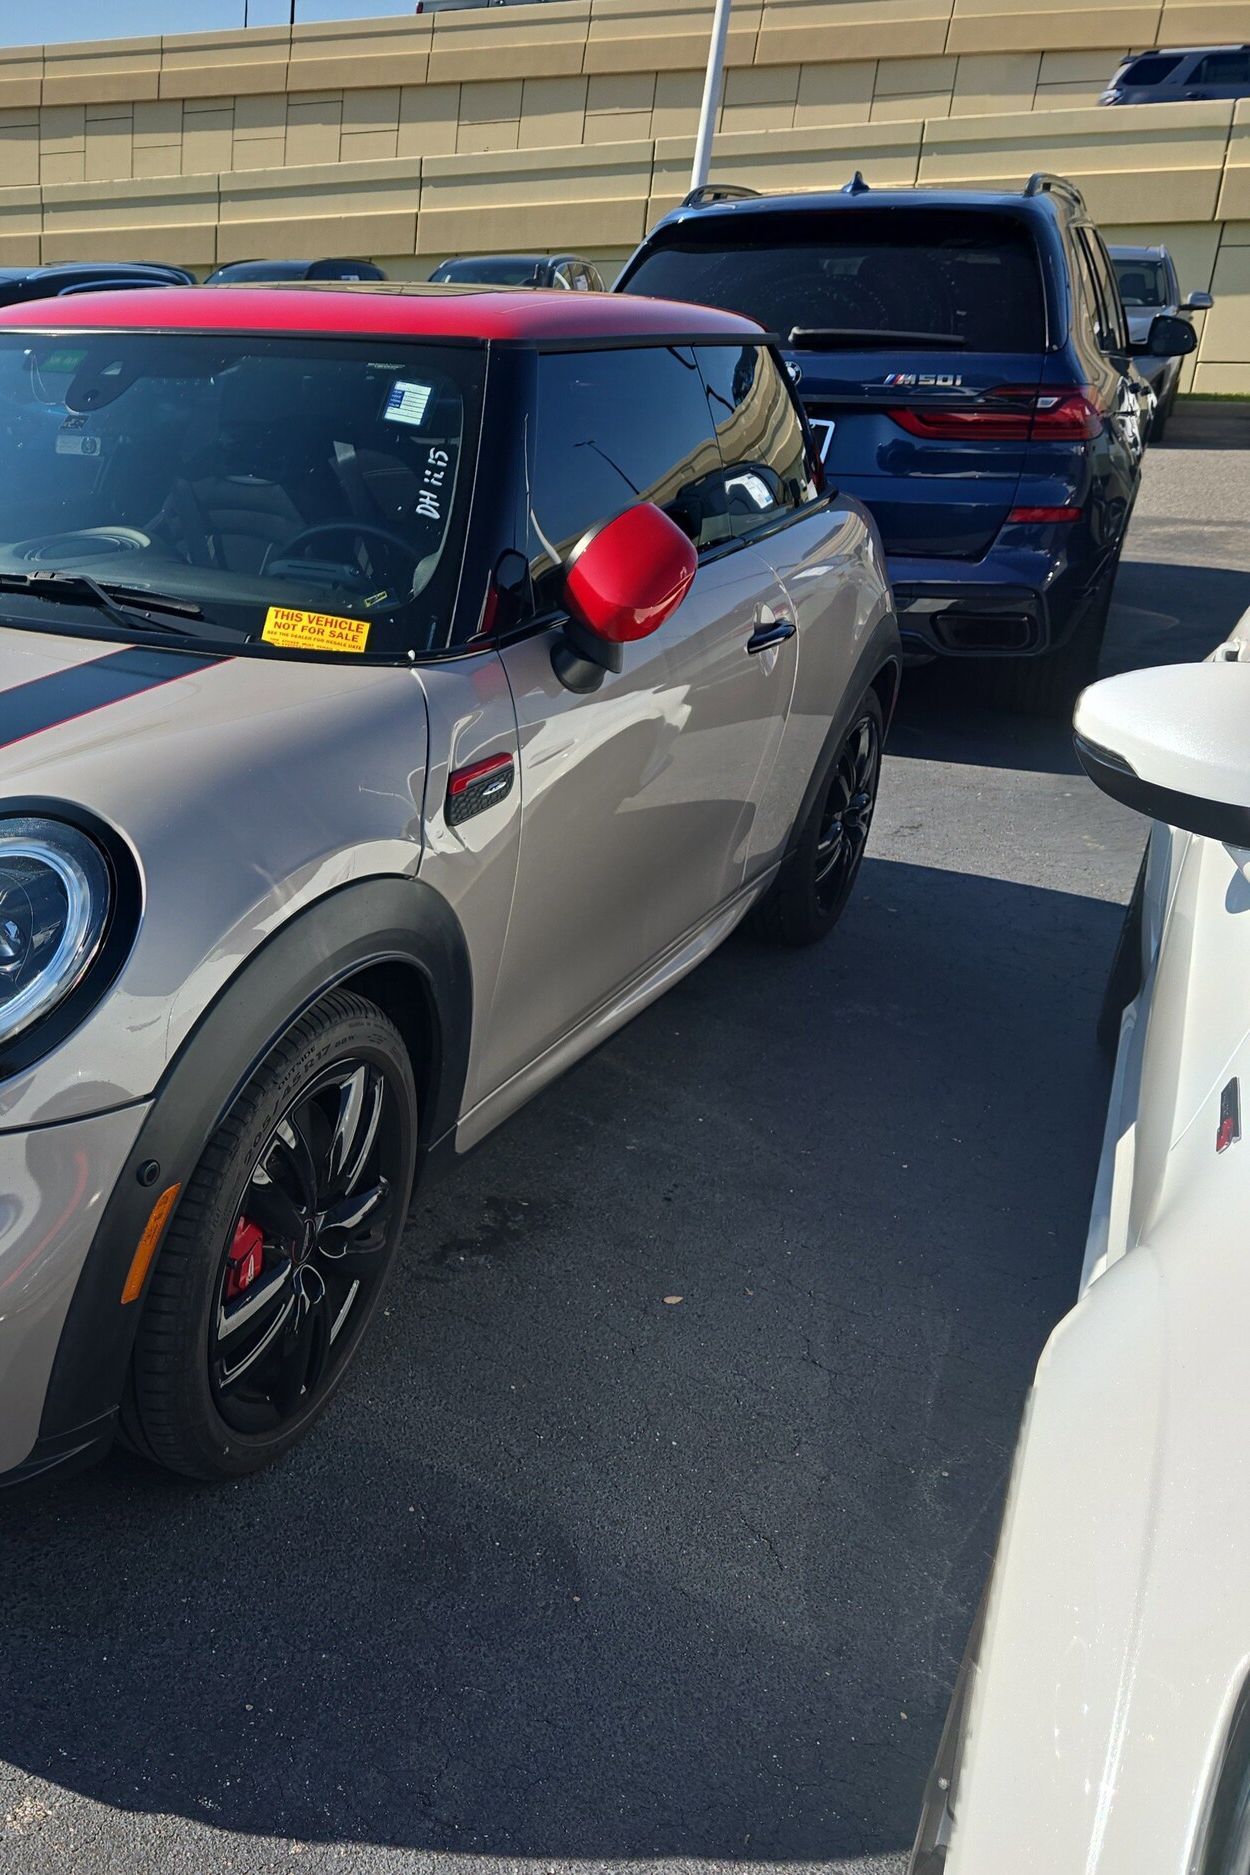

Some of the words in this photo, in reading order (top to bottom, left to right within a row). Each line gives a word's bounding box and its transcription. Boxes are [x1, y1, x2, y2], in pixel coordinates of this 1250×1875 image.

[415, 489, 440, 520] DH
[273, 609, 303, 622] THIS
[307, 614, 365, 634] VEHICLE
[273, 621, 299, 632] NOT
[301, 625, 326, 636] FOR
[328, 630, 360, 643] SALE
[290, 633, 312, 641] DEALER
[326, 639, 347, 648] RESALE
[277, 1045, 317, 1091] OUTSIDE
[304, 1042, 332, 1073] R17
